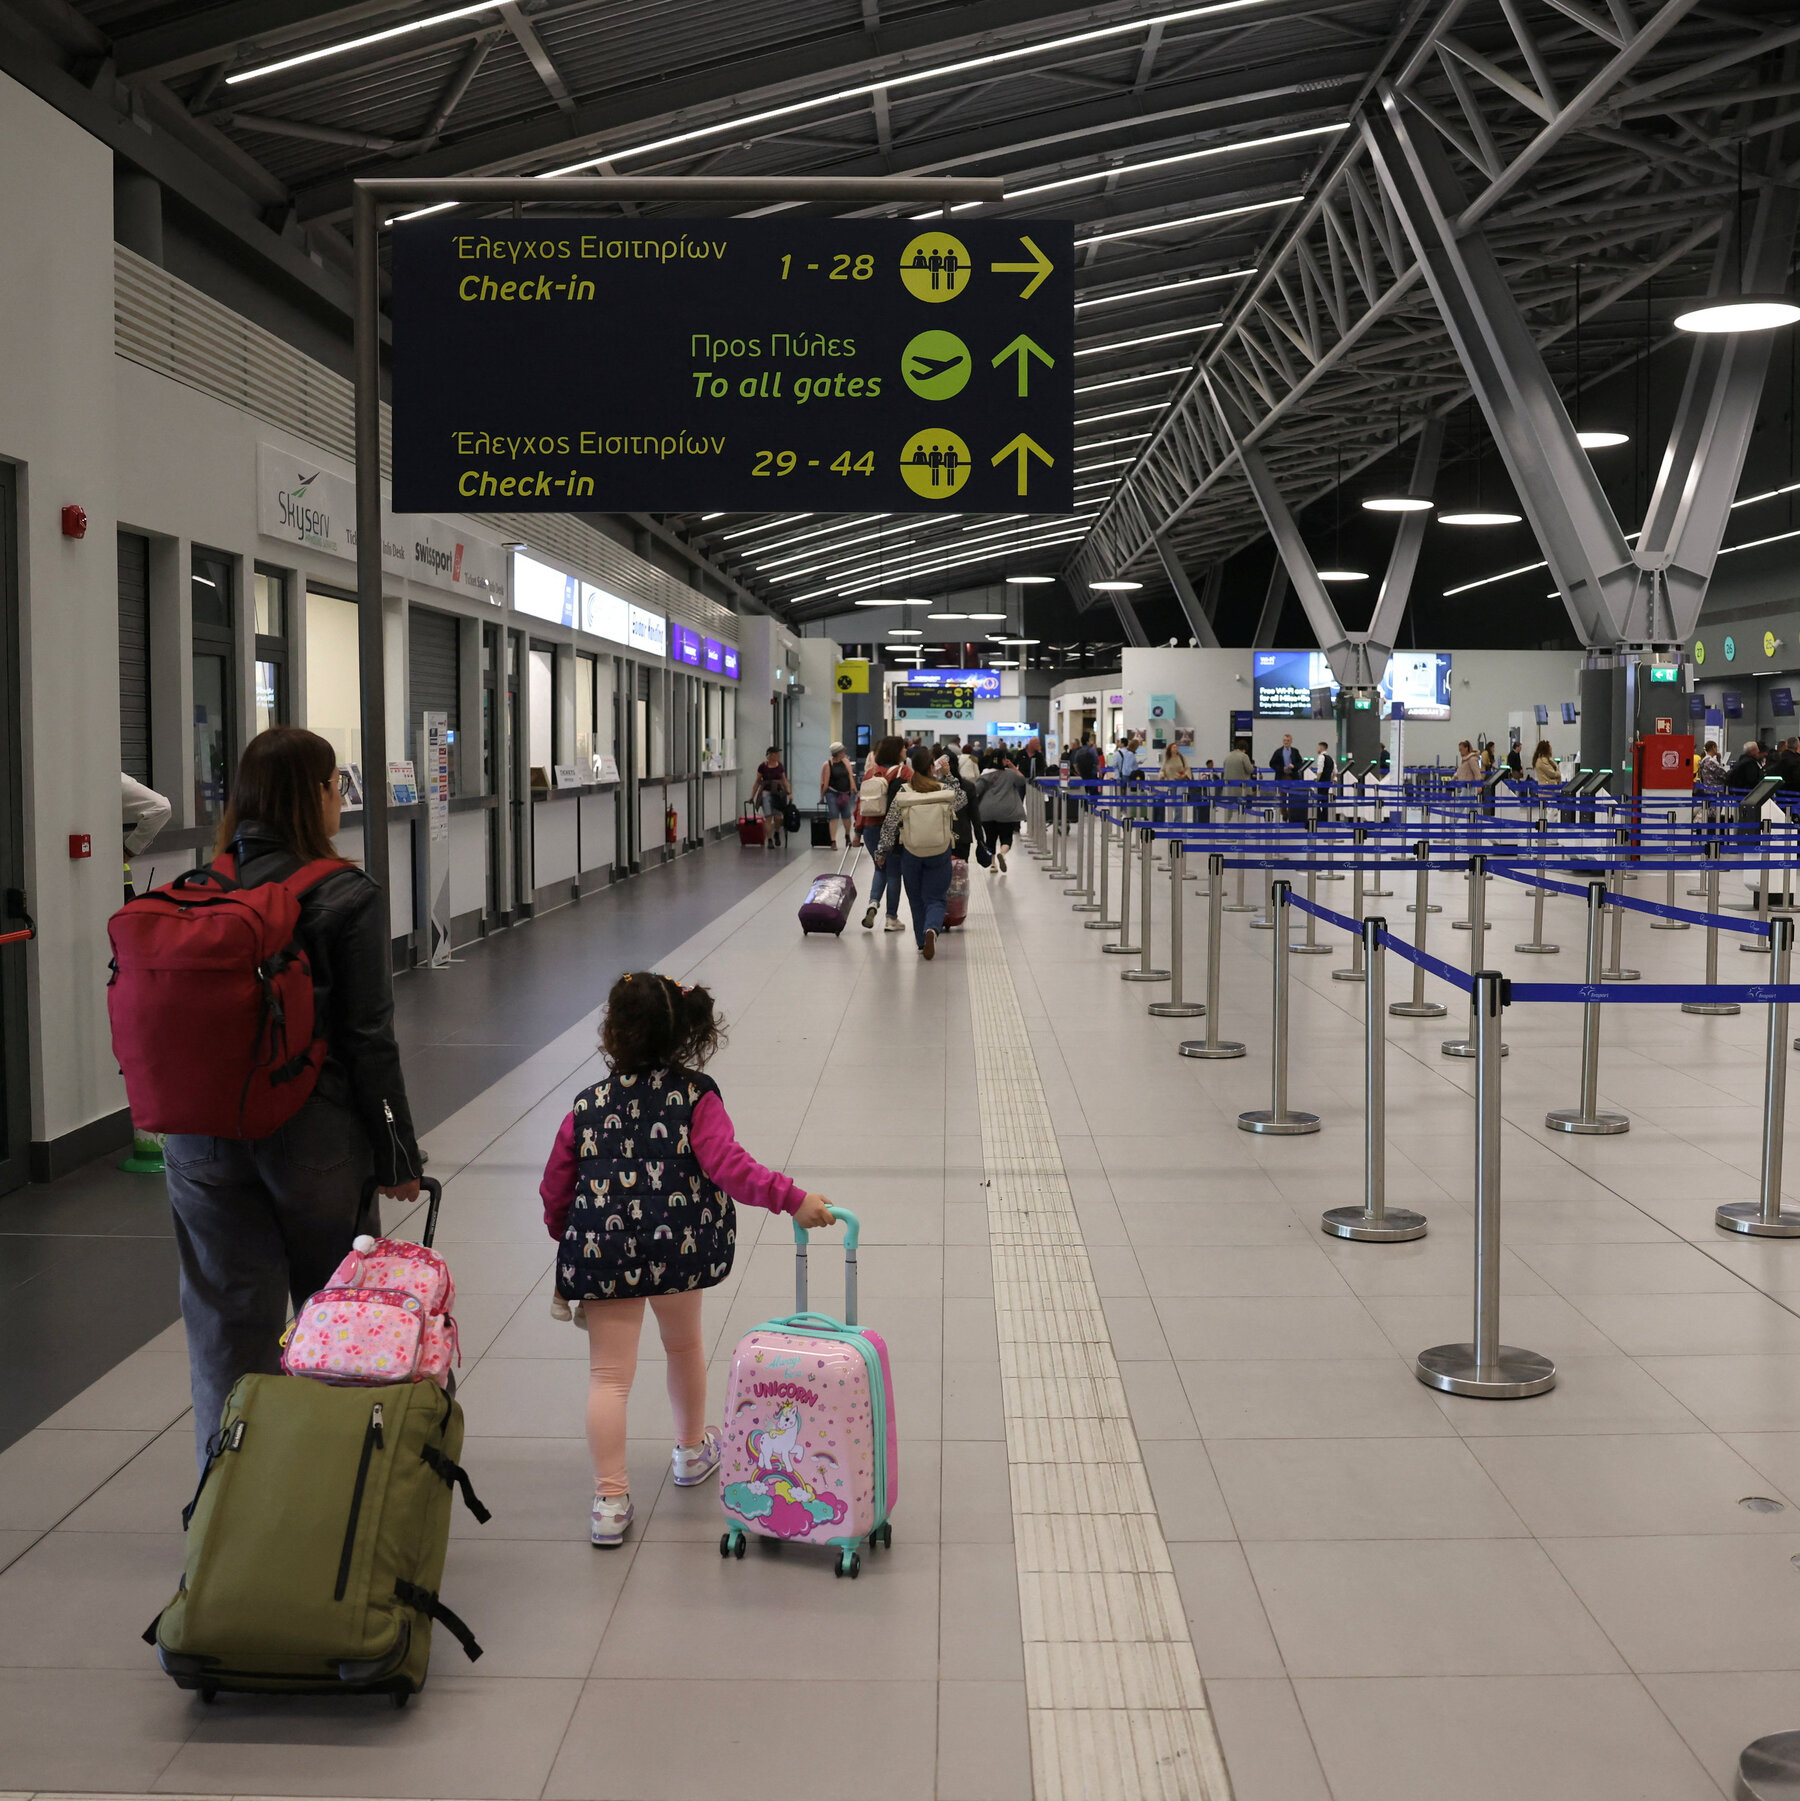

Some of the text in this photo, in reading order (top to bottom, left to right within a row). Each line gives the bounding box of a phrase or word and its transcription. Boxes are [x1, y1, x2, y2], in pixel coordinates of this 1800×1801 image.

[453, 233, 727, 264] Έλεγχος Εισιτηρίων
[781, 254, 792, 281] 1
[829, 253, 875, 281] 28
[459, 273, 596, 302] Check-in
[691, 331, 857, 363] Προς Πύλες
[692, 371, 883, 405] To all gates
[452, 429, 726, 460] Έλεγχος Εισιτηρίων
[751, 450, 798, 477] 29
[829, 450, 875, 477] 44
[459, 469, 595, 497] Check-in
[278, 490, 331, 541] Skyserv
[415, 536, 453, 576] swissport
[753, 1380, 819, 1408] UNICORN
